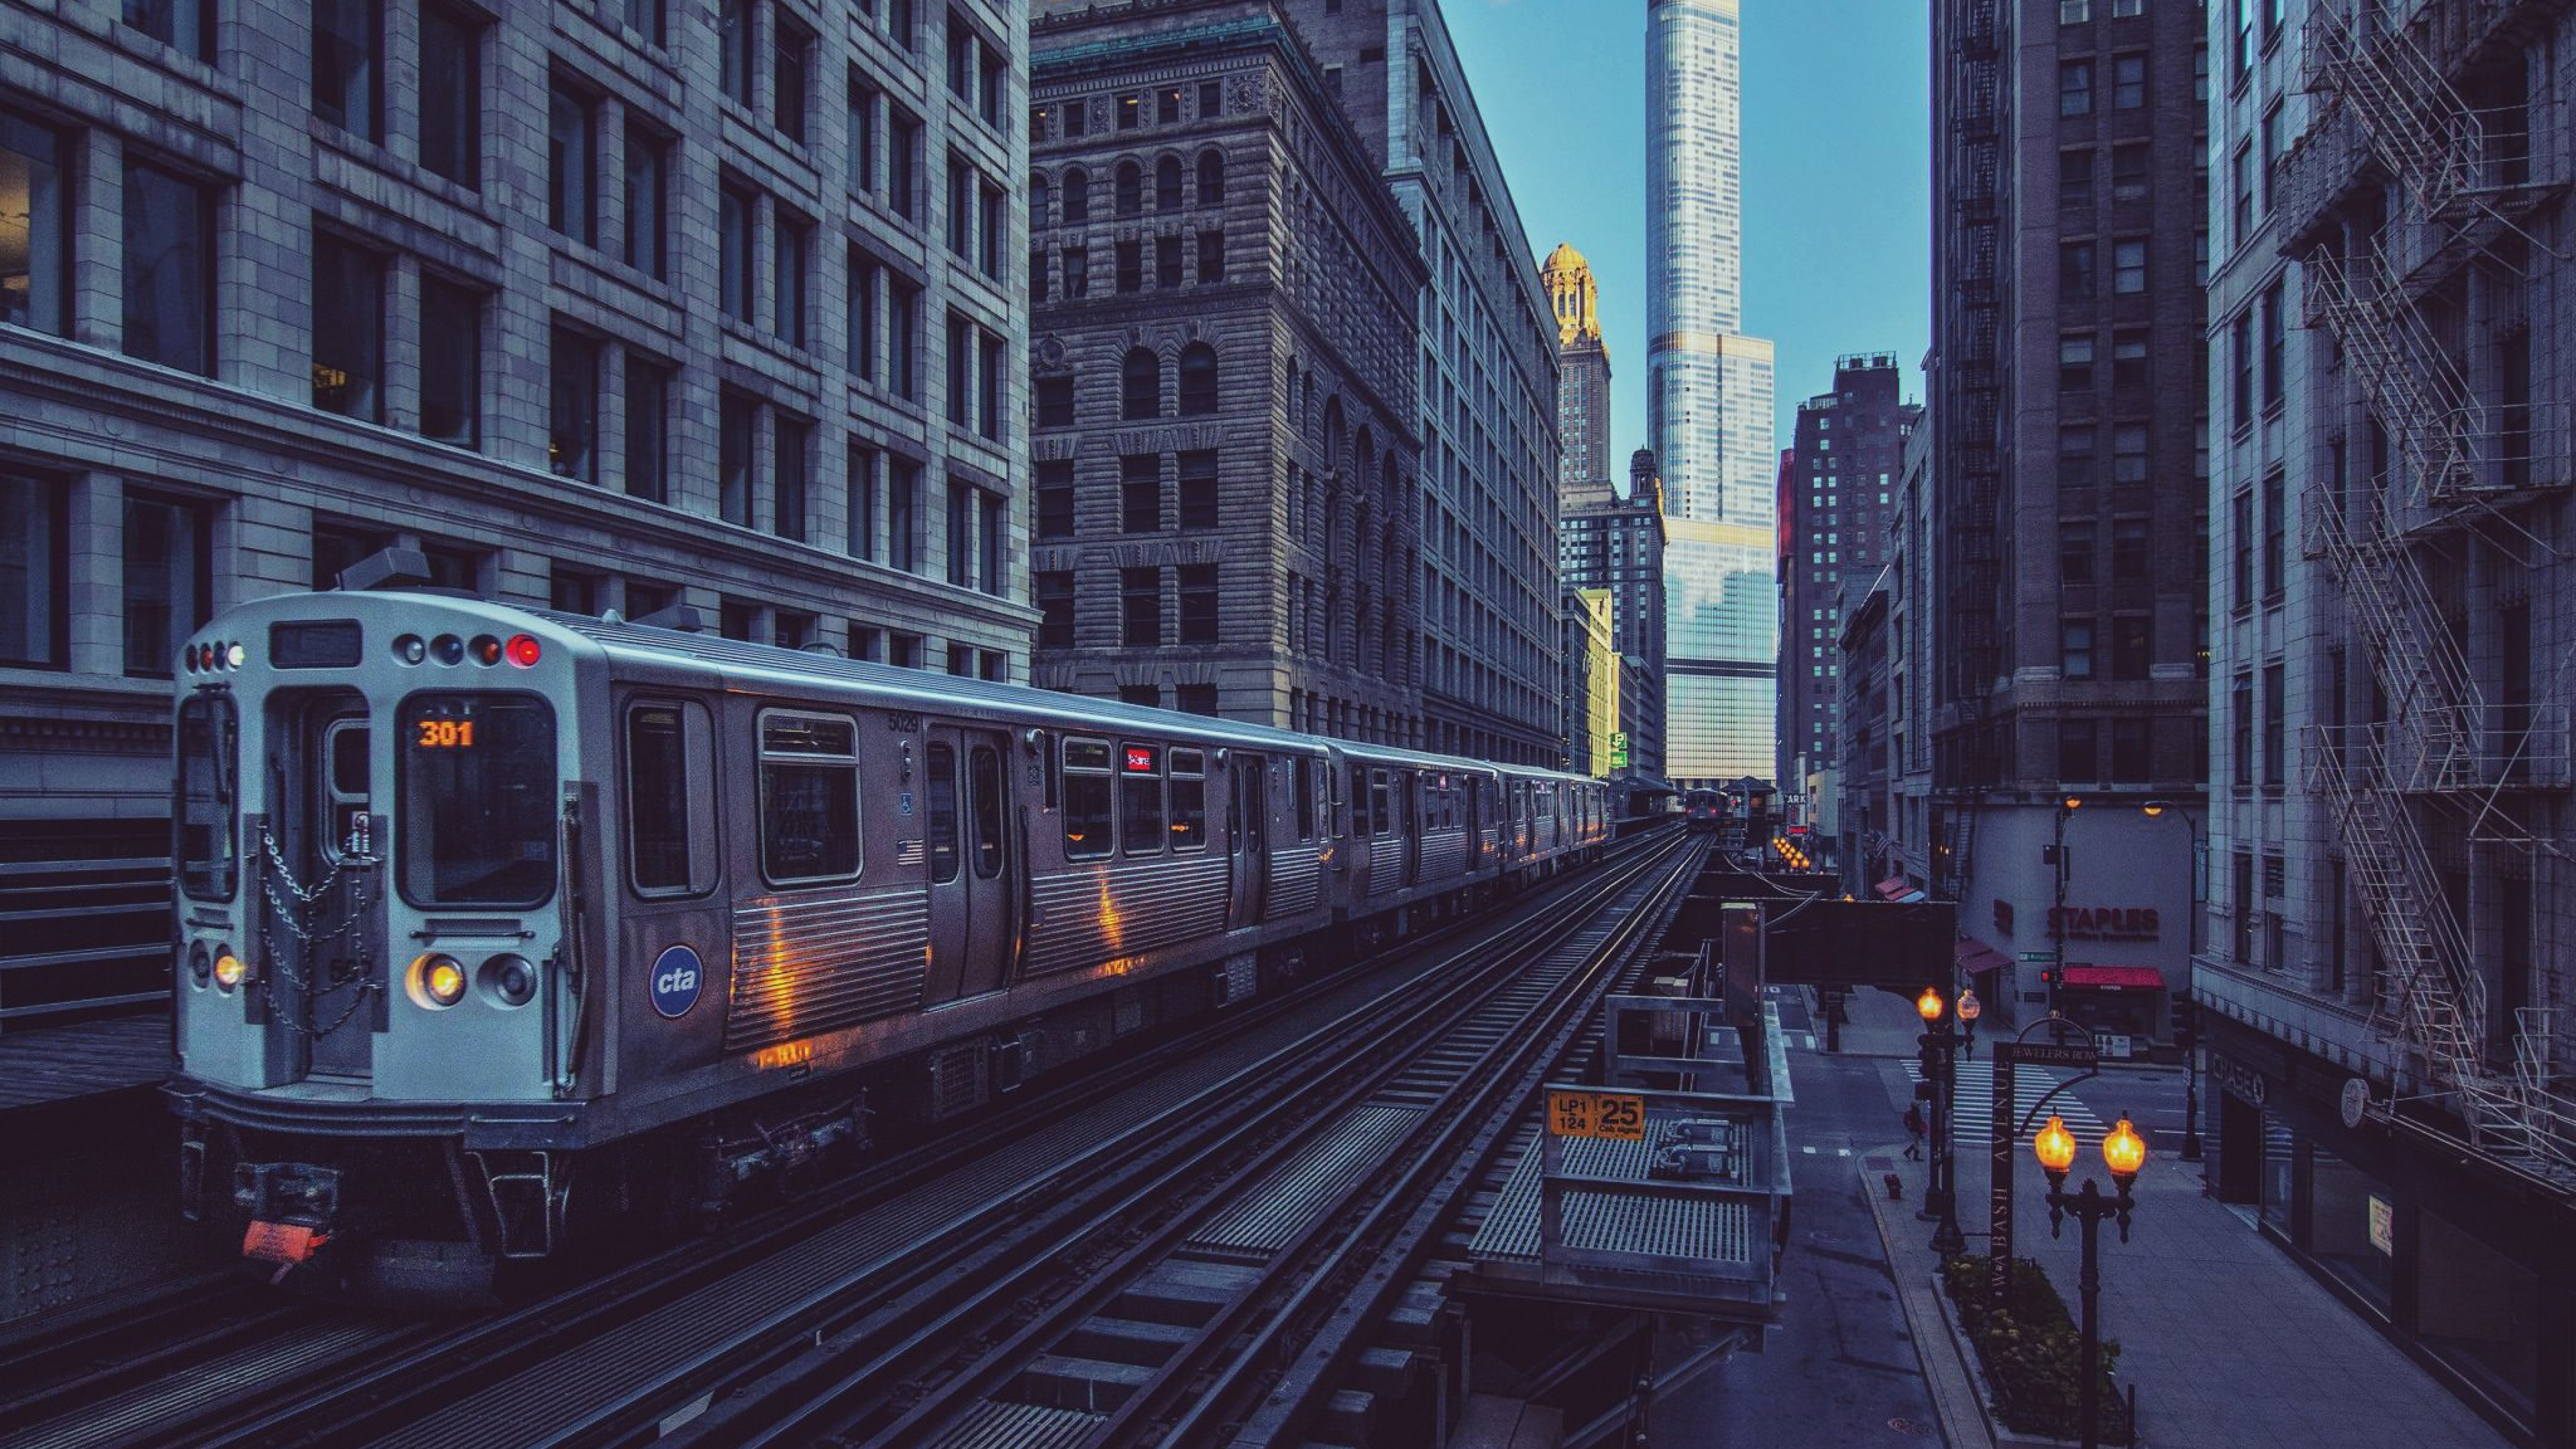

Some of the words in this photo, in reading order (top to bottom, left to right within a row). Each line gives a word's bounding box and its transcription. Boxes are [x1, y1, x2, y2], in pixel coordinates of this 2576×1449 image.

[419, 720, 473, 746] 301
[889, 712, 918, 733] 5029
[2048, 908, 2159, 930] STAPLES
[659, 968, 695, 994] cta
[1560, 1098, 1586, 1113] LP1
[1601, 1099, 1638, 1125] 25
[1994, 1062, 2009, 1163] AVENUE
[1560, 1117, 1585, 1129] 124
[1992, 1188, 2007, 1287] WABASH
